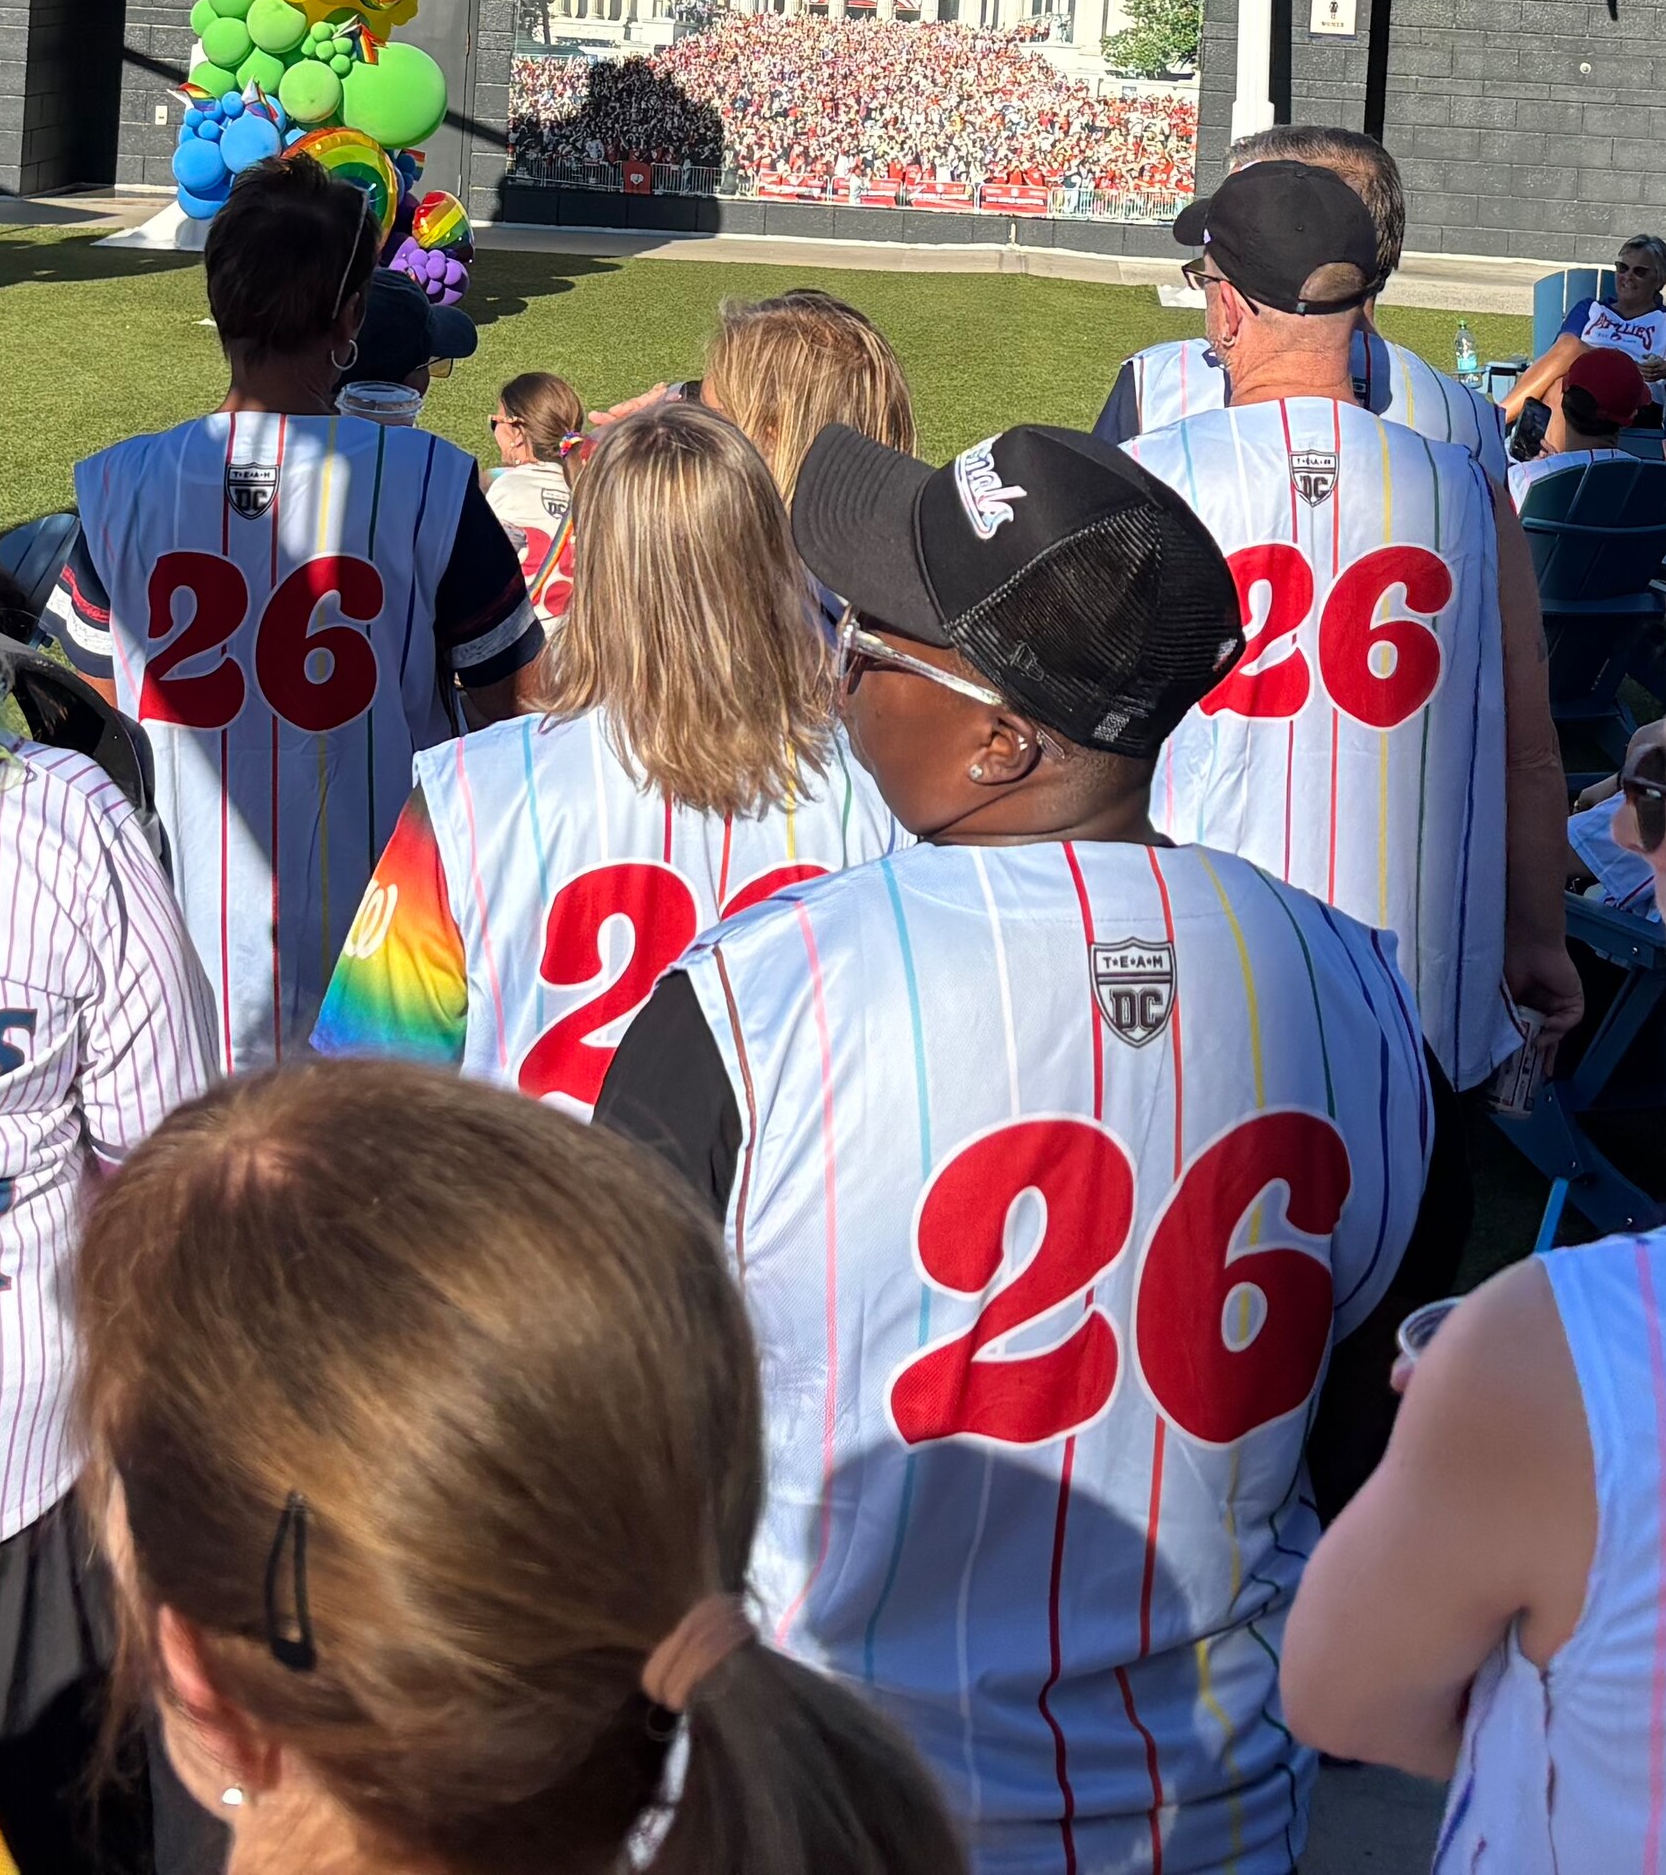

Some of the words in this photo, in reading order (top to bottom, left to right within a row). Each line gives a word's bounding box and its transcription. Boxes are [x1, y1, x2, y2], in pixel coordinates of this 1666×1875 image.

[235, 488, 268, 511] DC
[1299, 475, 1329, 499] DC
[139, 550, 384, 731] 26
[1199, 542, 1454, 729] 26
[517, 859, 833, 1110] 2
[1110, 986, 1164, 1032] DC
[885, 1112, 1352, 1447] 26
